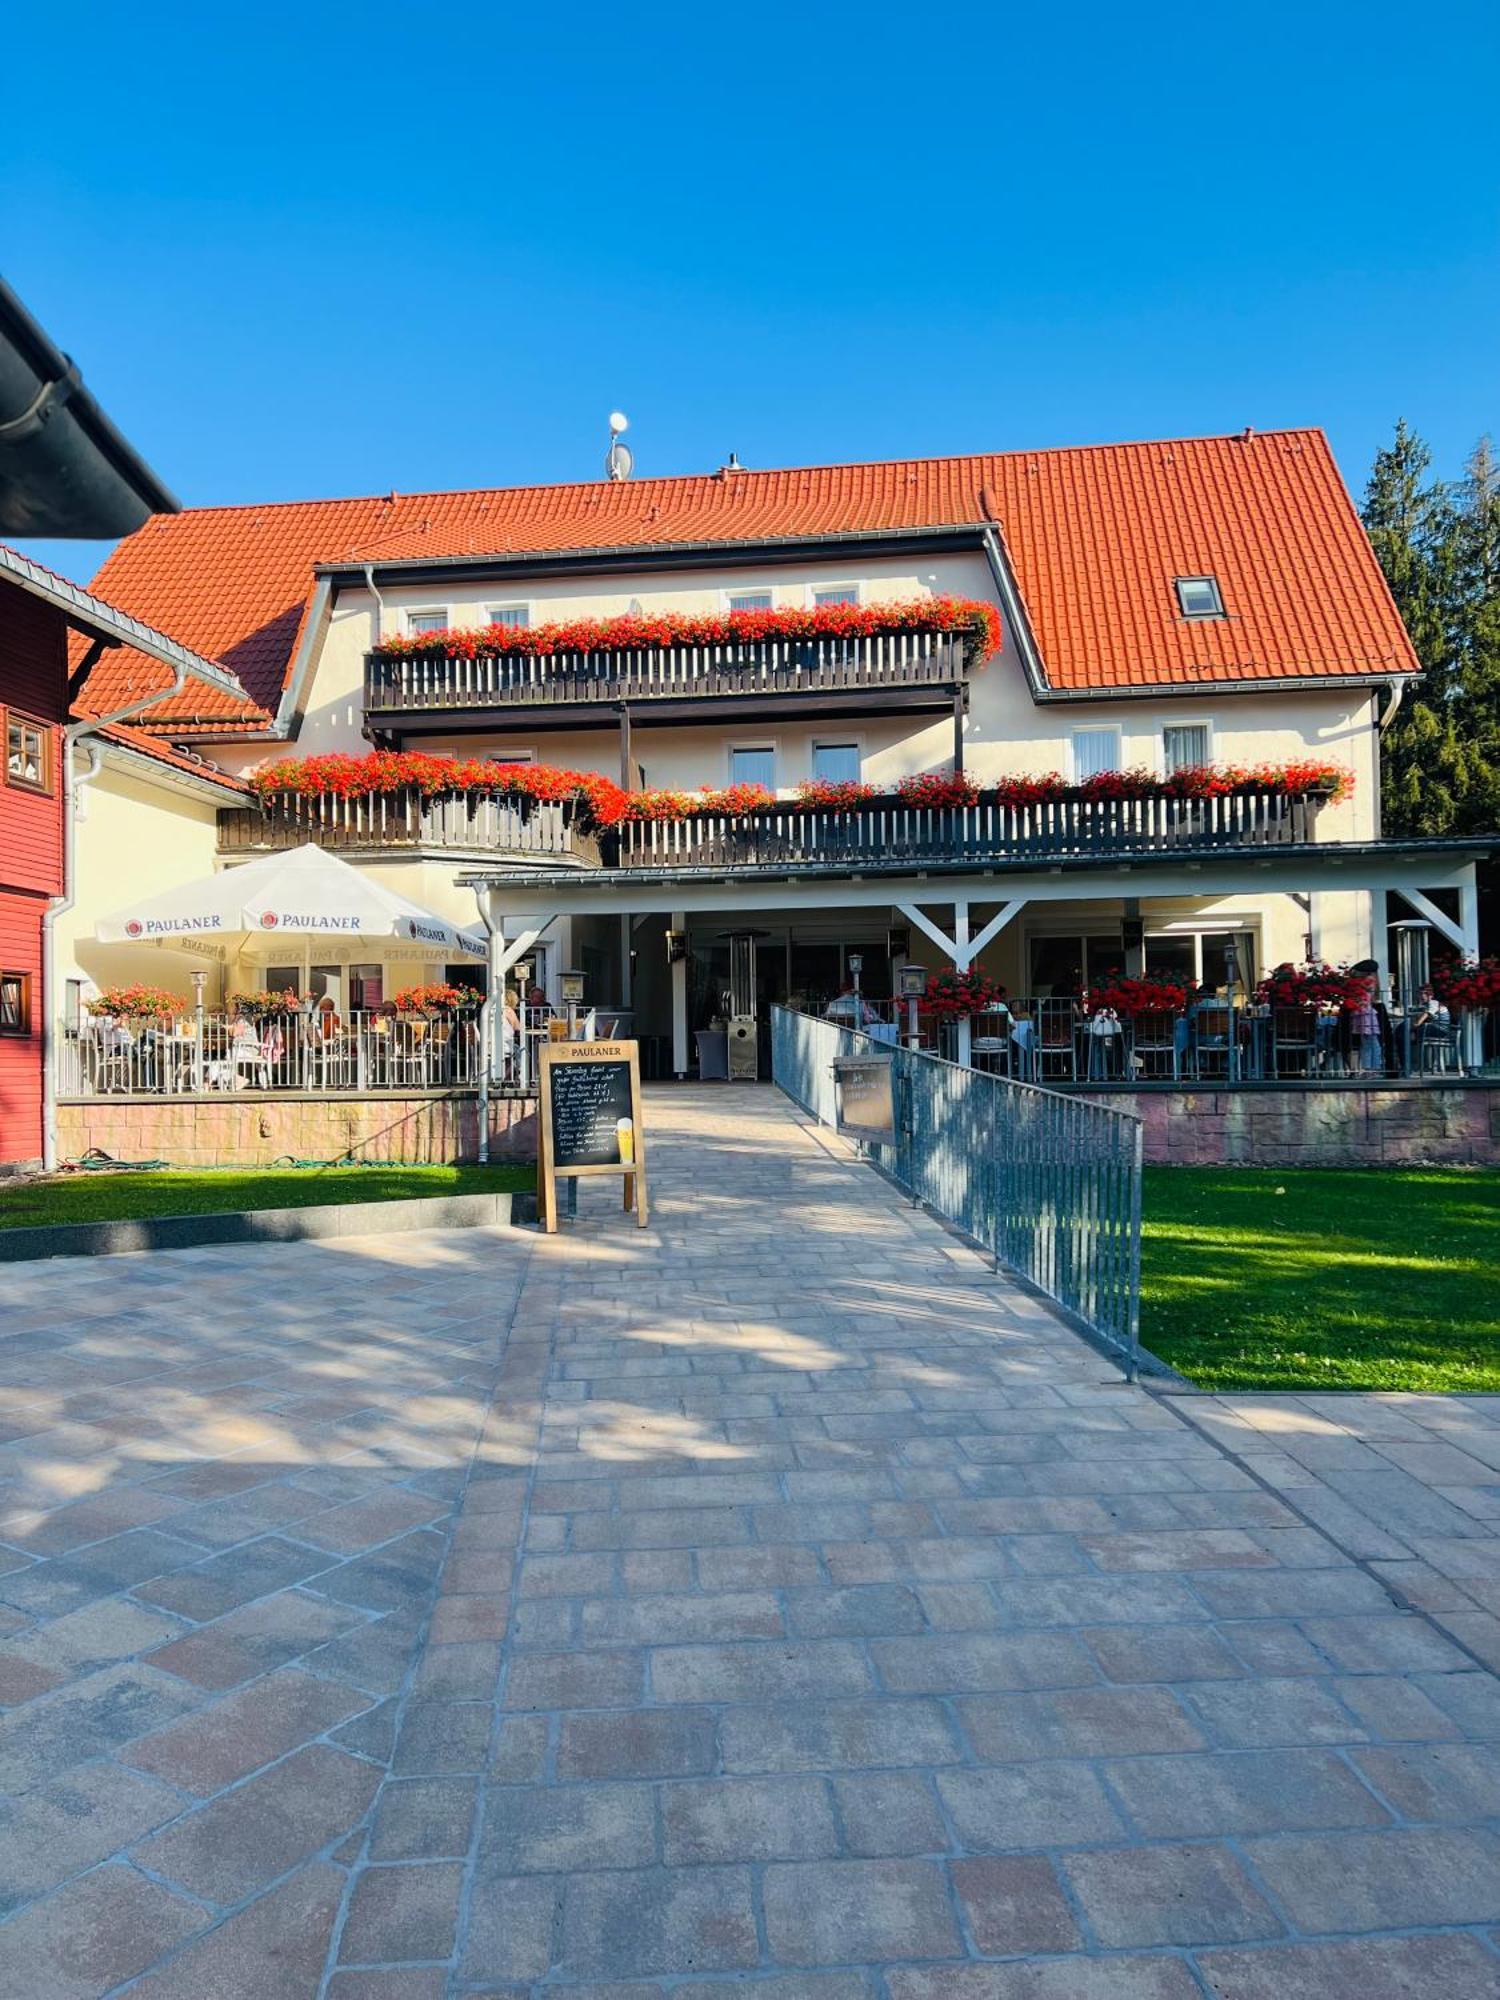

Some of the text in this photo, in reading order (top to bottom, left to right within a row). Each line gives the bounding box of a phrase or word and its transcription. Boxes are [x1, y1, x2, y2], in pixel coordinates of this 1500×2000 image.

[146, 914, 221, 932] PAULANER
[282, 914, 360, 928] PAULANER
[417, 924, 446, 941] PAULANER
[571, 1047, 621, 1057] PAULANER
